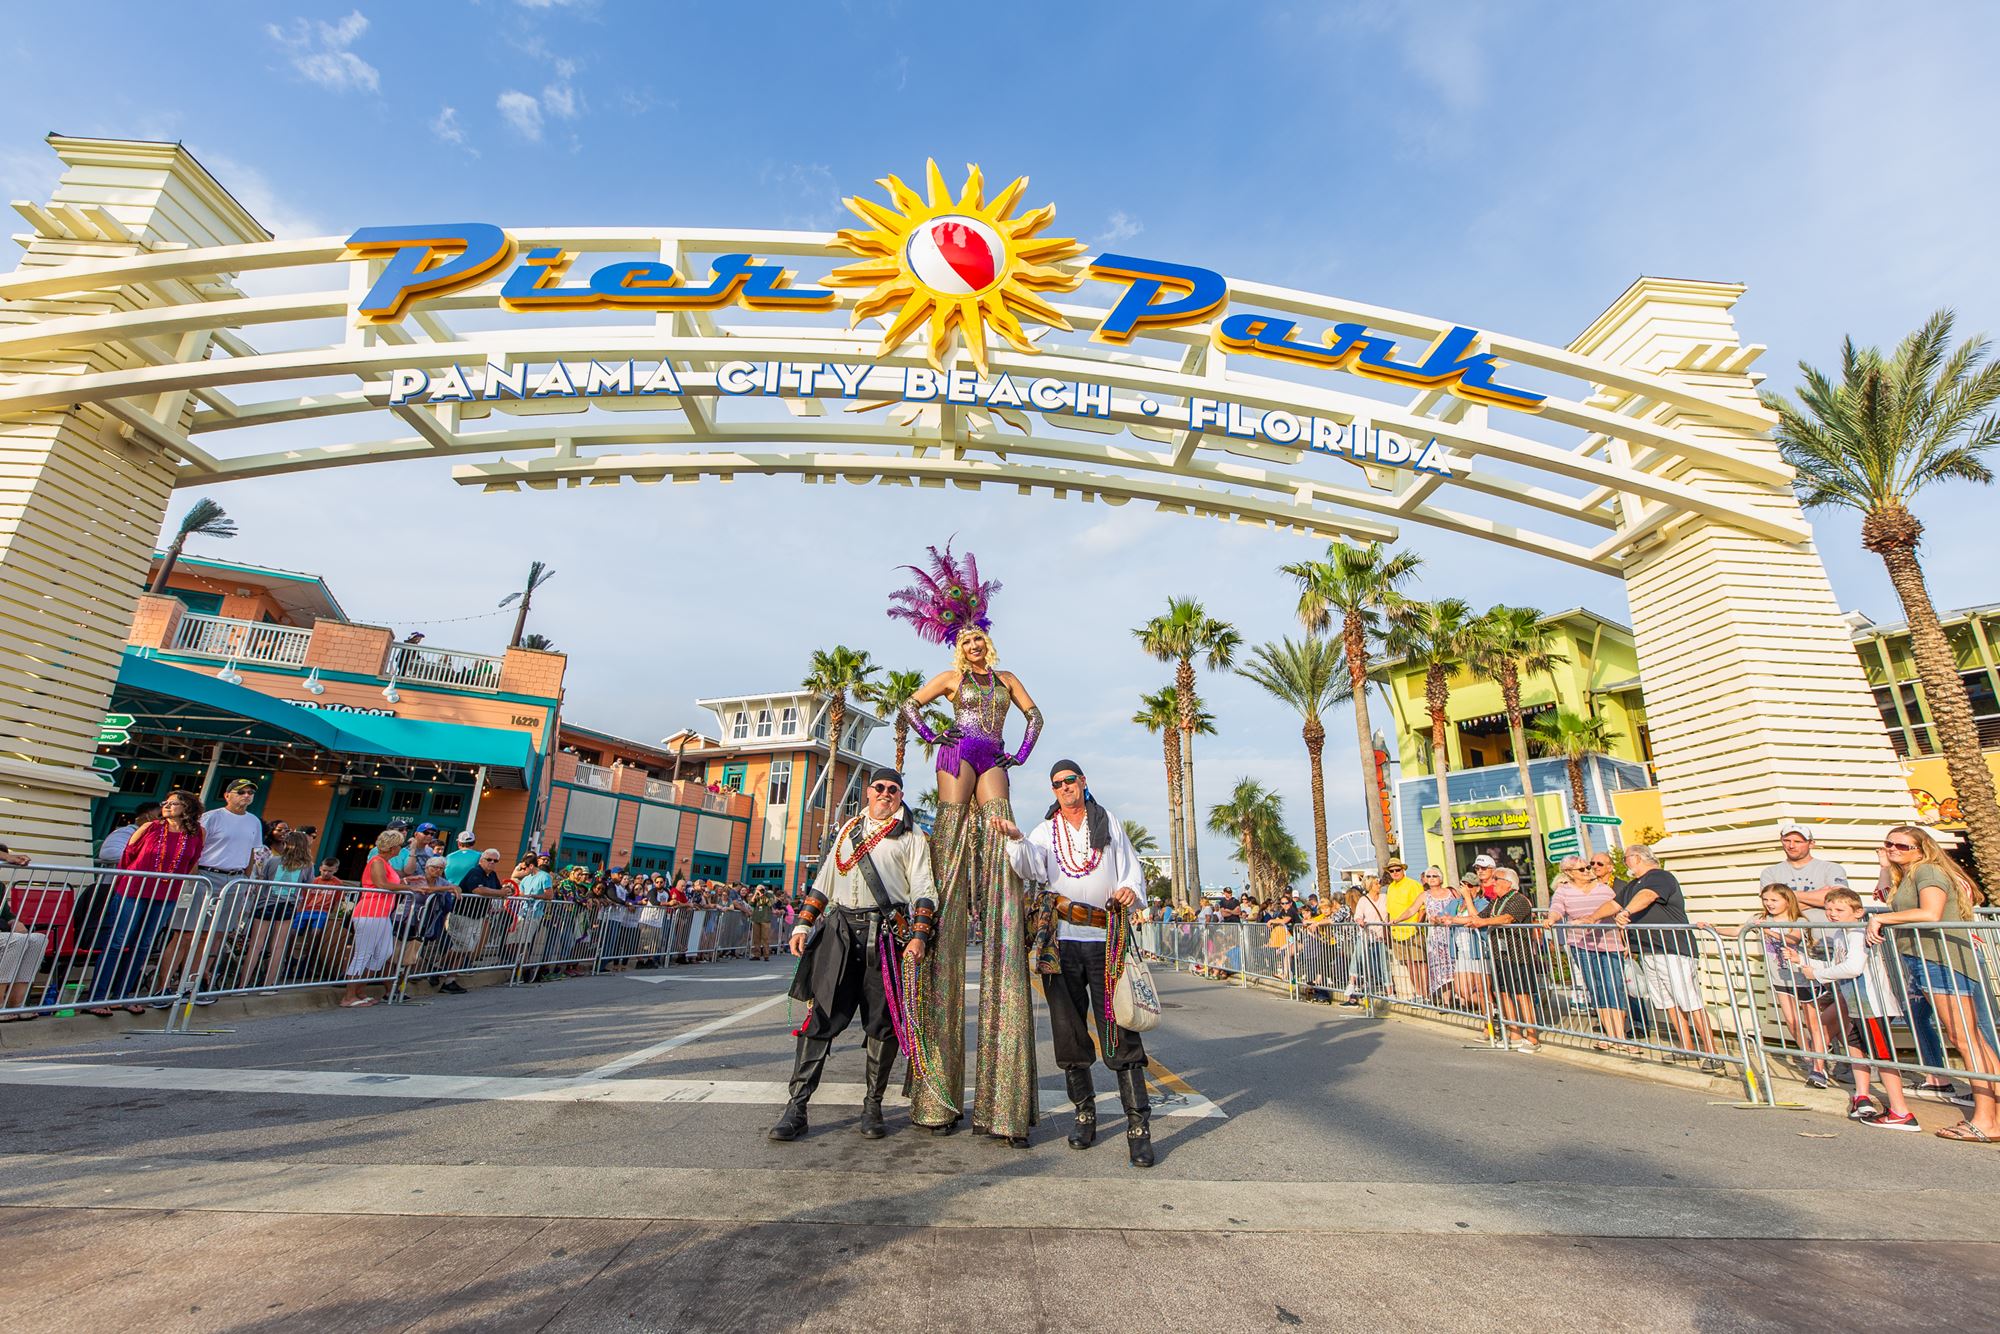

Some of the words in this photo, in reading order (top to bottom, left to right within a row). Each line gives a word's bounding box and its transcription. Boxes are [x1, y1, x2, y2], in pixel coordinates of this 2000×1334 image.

[342, 222, 840, 324] Pier
[1088, 252, 1549, 411] Park
[389, 356, 685, 405] PANAMA
[715, 358, 875, 399] CITY
[903, 364, 1113, 418] BEACH
[1189, 396, 1454, 477] FLORIDA
[511, 715, 539, 728] 16220
[1468, 815, 1502, 828] DRINK
[1503, 809, 1530, 829] laugh
